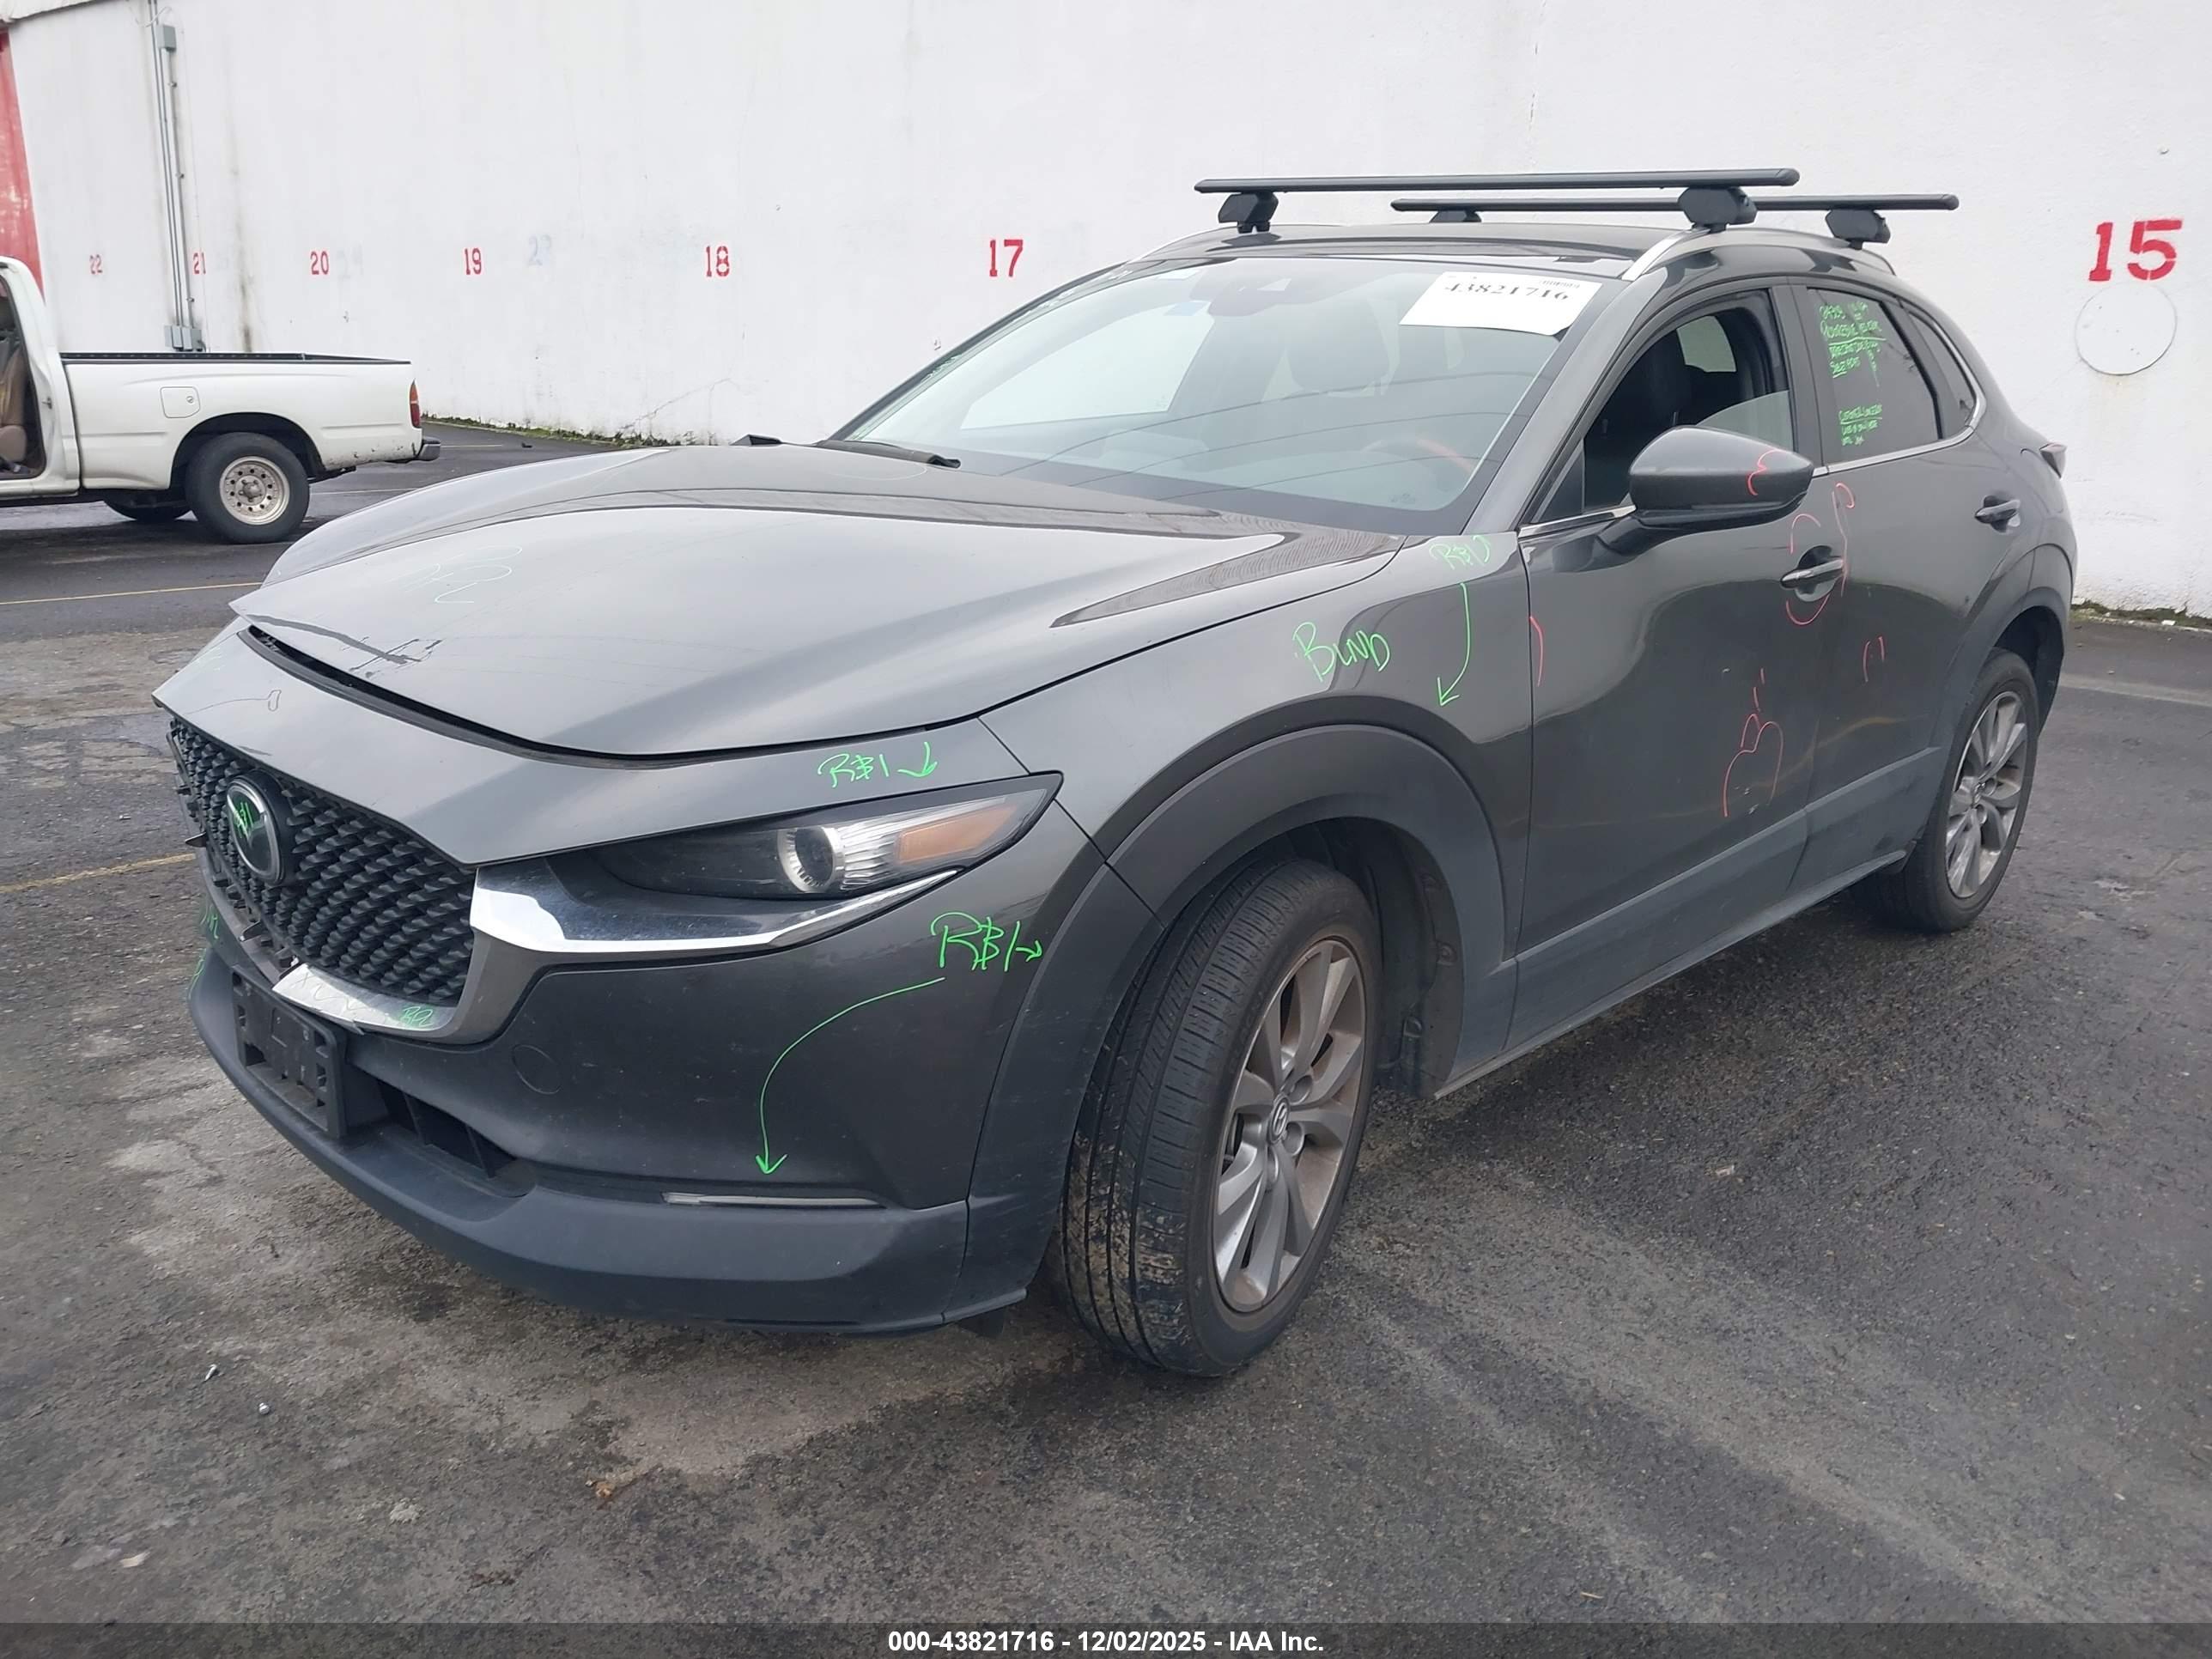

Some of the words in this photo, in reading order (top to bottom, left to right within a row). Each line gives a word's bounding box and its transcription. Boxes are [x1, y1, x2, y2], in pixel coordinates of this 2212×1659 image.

[193, 252, 207, 274] 21
[310, 251, 330, 275] 20
[465, 248, 483, 275] 19
[706, 246, 730, 277] 18
[989, 240, 1024, 276] 17
[2089, 220, 2183, 282] 15
[89, 254, 103, 274] 22
[1444, 282, 1569, 301] 43821716
